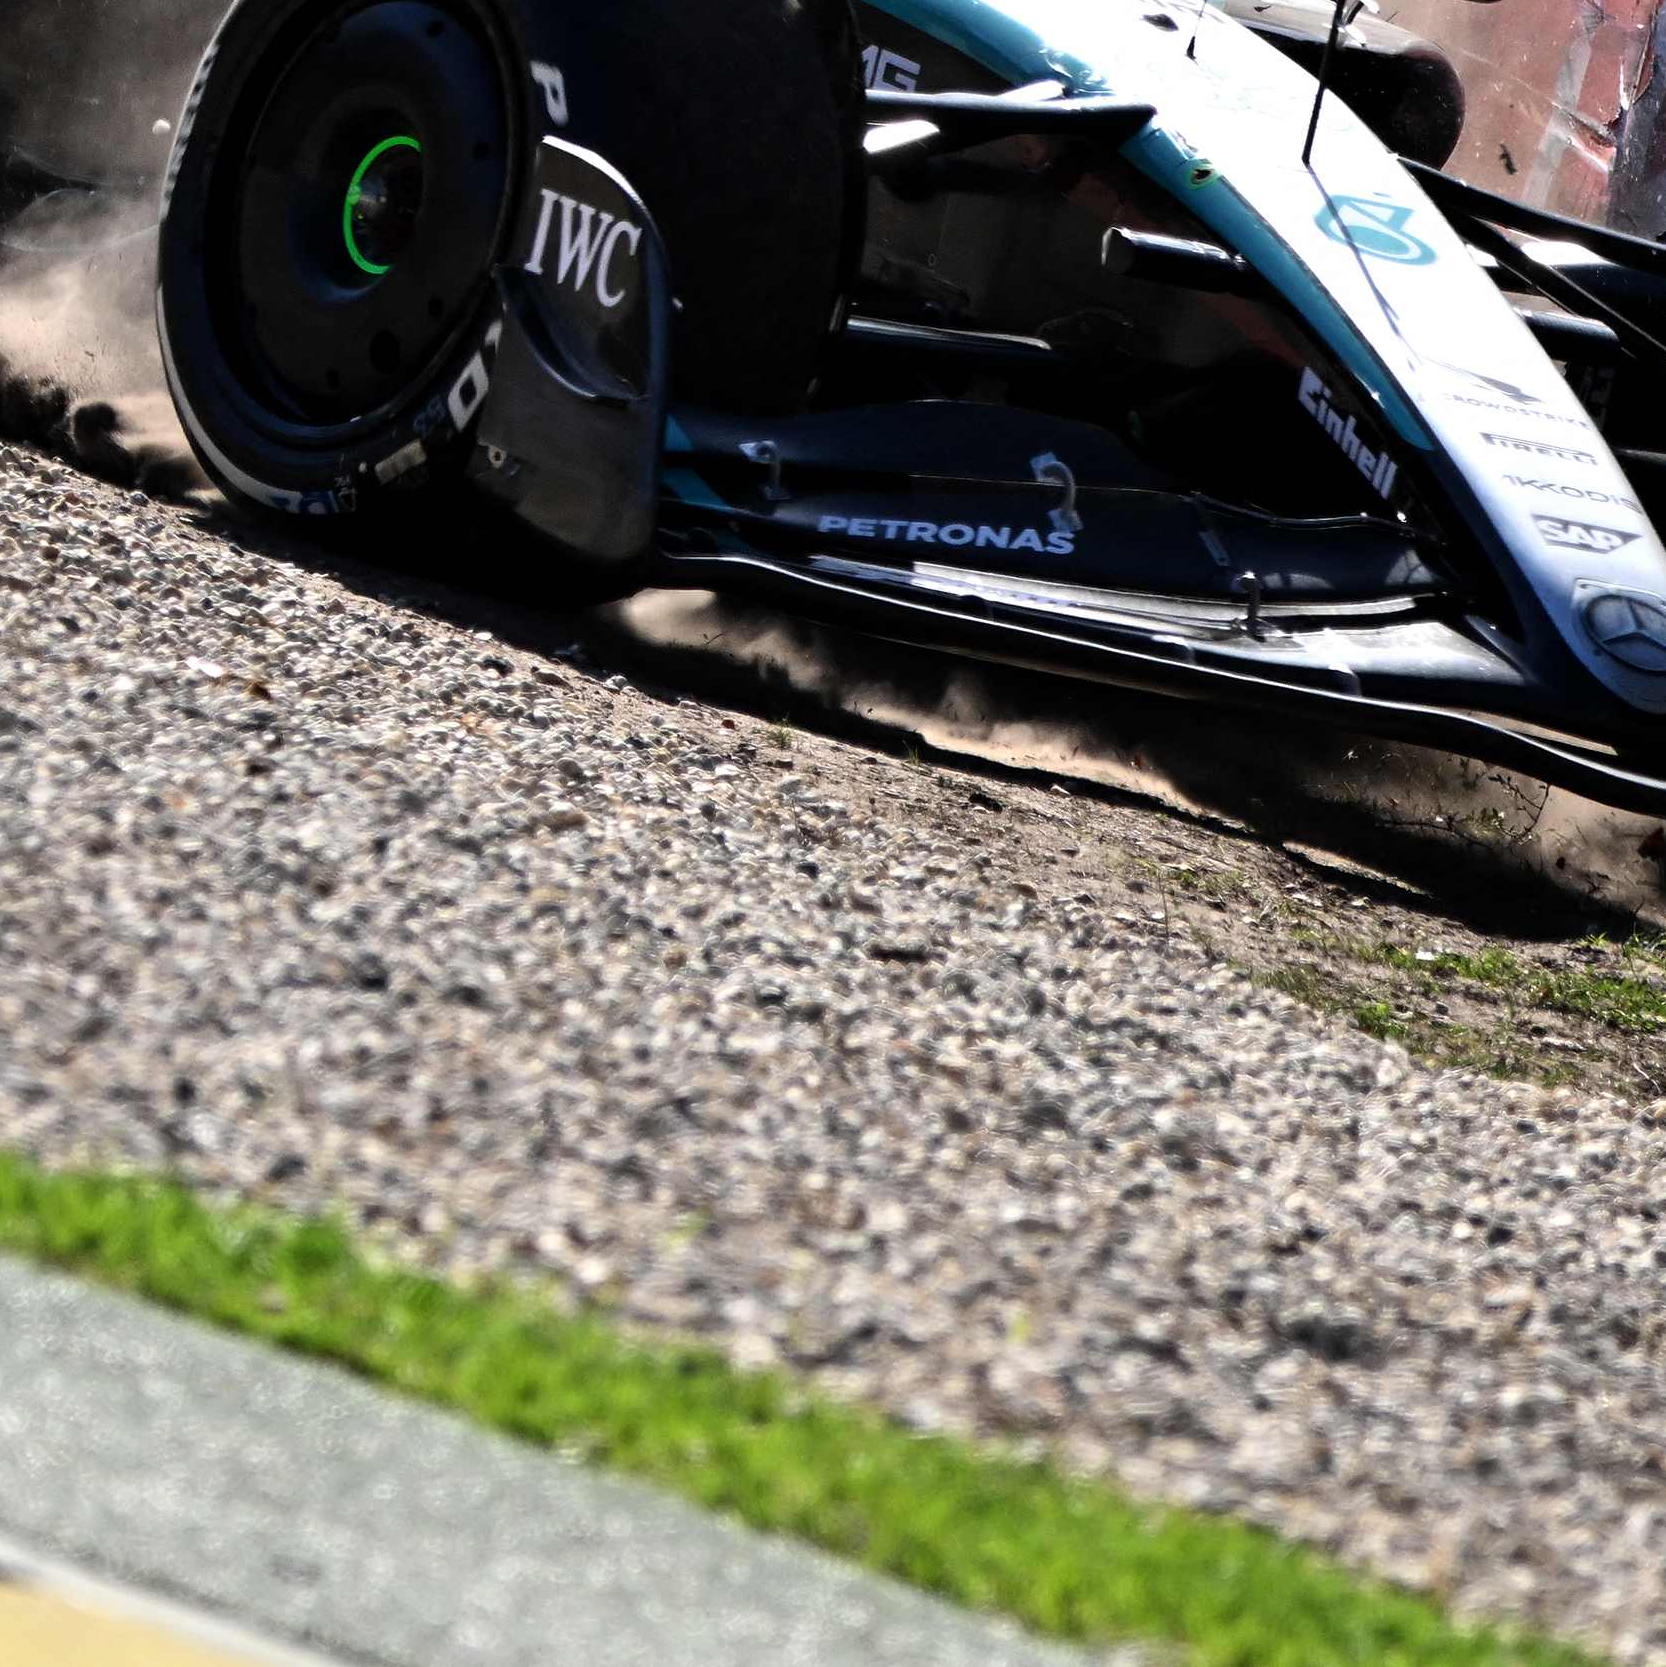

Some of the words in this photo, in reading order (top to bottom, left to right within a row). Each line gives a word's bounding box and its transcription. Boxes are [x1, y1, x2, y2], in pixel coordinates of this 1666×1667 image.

[525, 188, 642, 308] IWC
[1298, 366, 1399, 500] Einhell
[1479, 431, 1599, 467] PIRELLI
[817, 515, 1076, 555] PETRONAS
[1536, 518, 1625, 552] SAP
